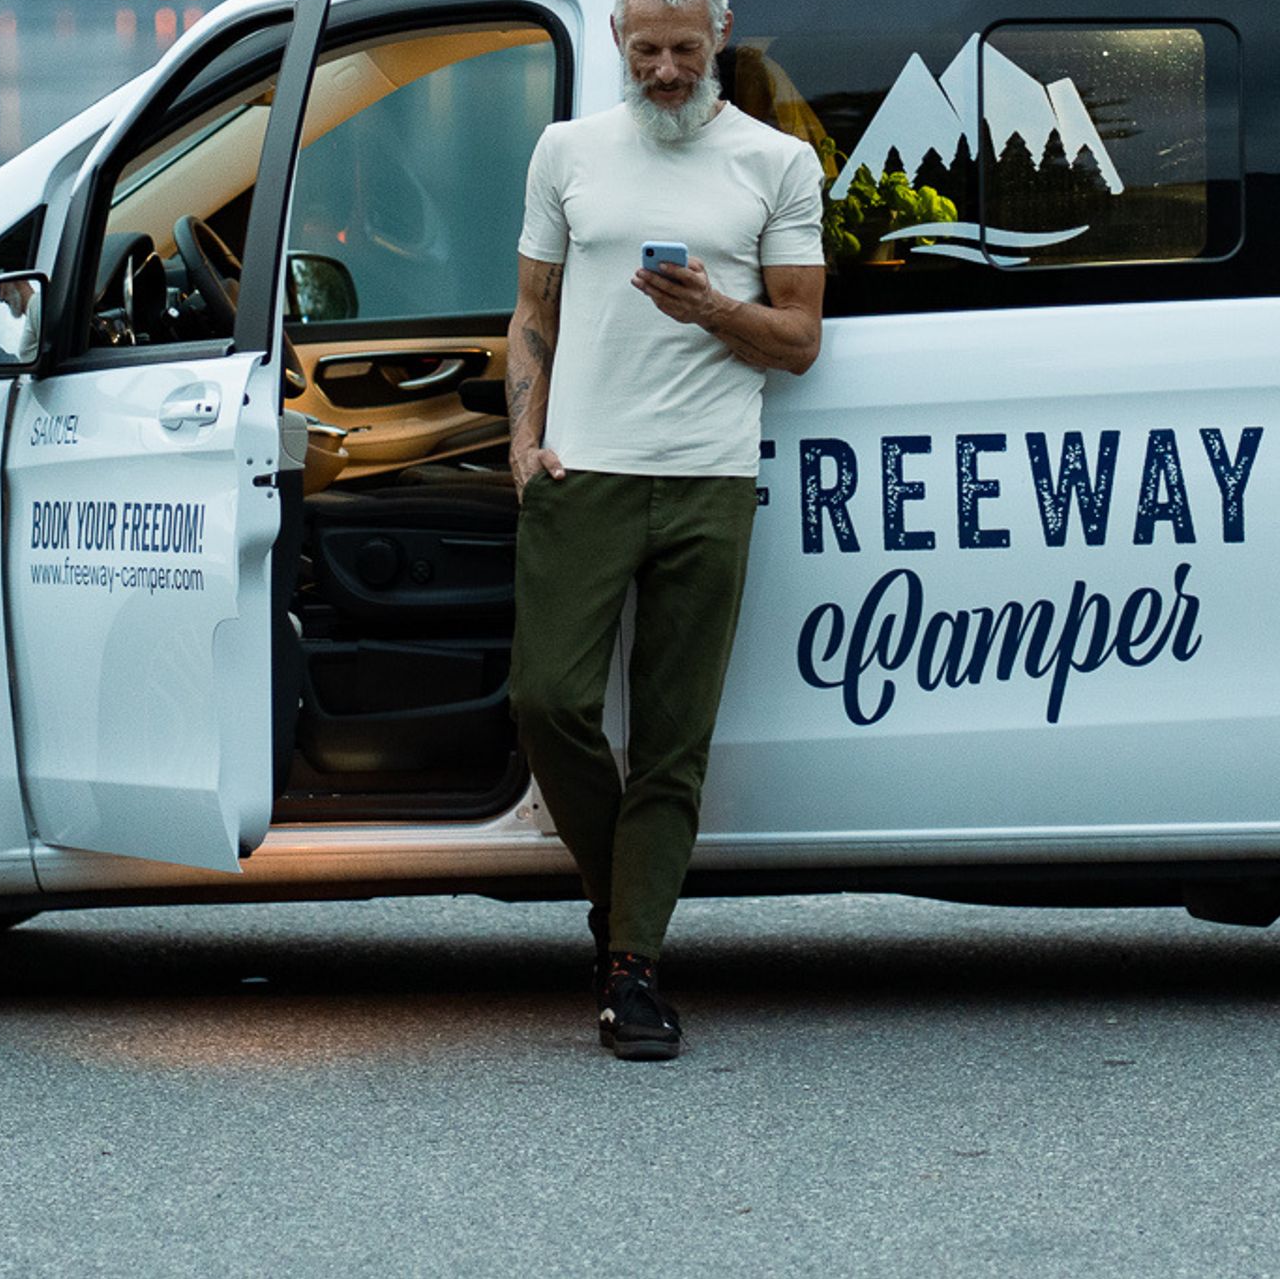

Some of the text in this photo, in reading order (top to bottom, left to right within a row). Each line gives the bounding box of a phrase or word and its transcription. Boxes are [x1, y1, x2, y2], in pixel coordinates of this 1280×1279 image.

[31, 501, 206, 554] BOOK YOUR FREEDOM!
[31, 557, 204, 595] www.freeway-camper.com
[797, 563, 1202, 726] Camper
